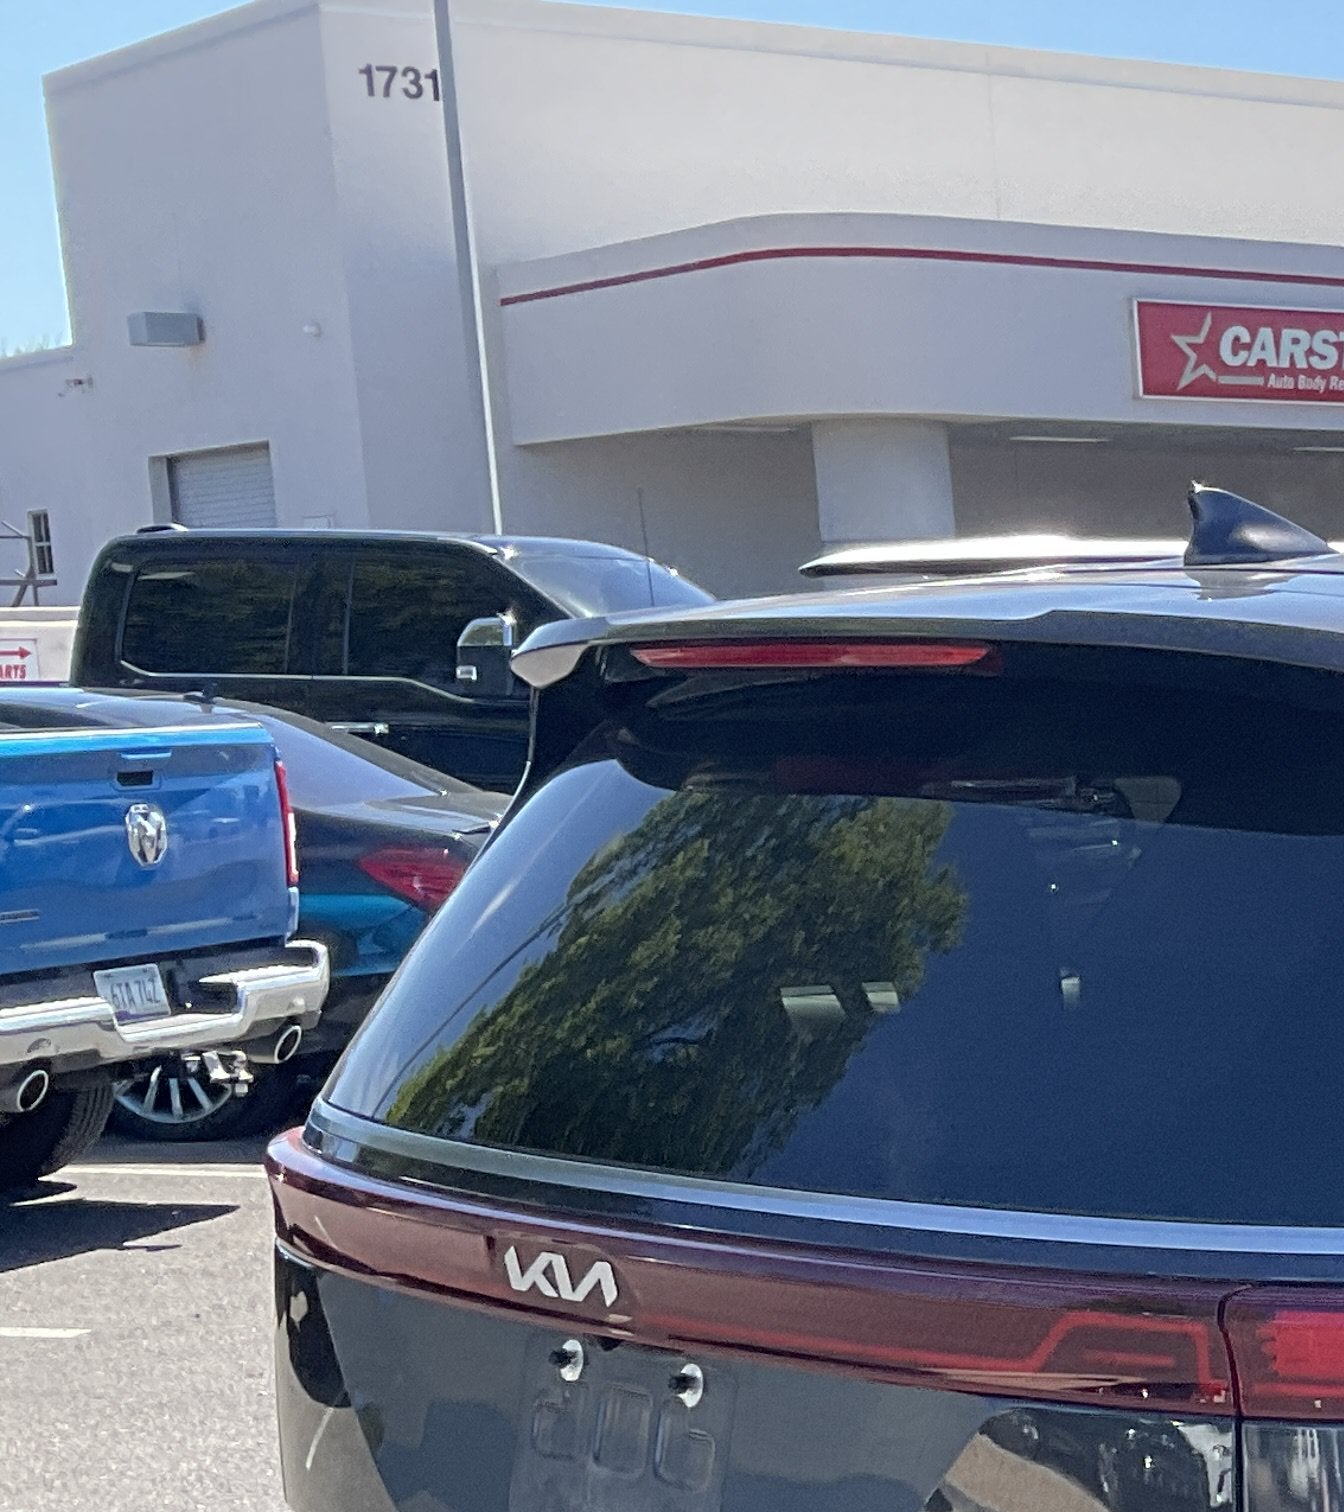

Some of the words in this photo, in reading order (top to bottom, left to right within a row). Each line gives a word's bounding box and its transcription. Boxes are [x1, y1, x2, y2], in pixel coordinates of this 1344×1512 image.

[358, 63, 440, 101] 1731
[1267, 373, 1294, 389] Auto
[1298, 375, 1326, 393] Body
[504, 1246, 618, 1307] KIA
